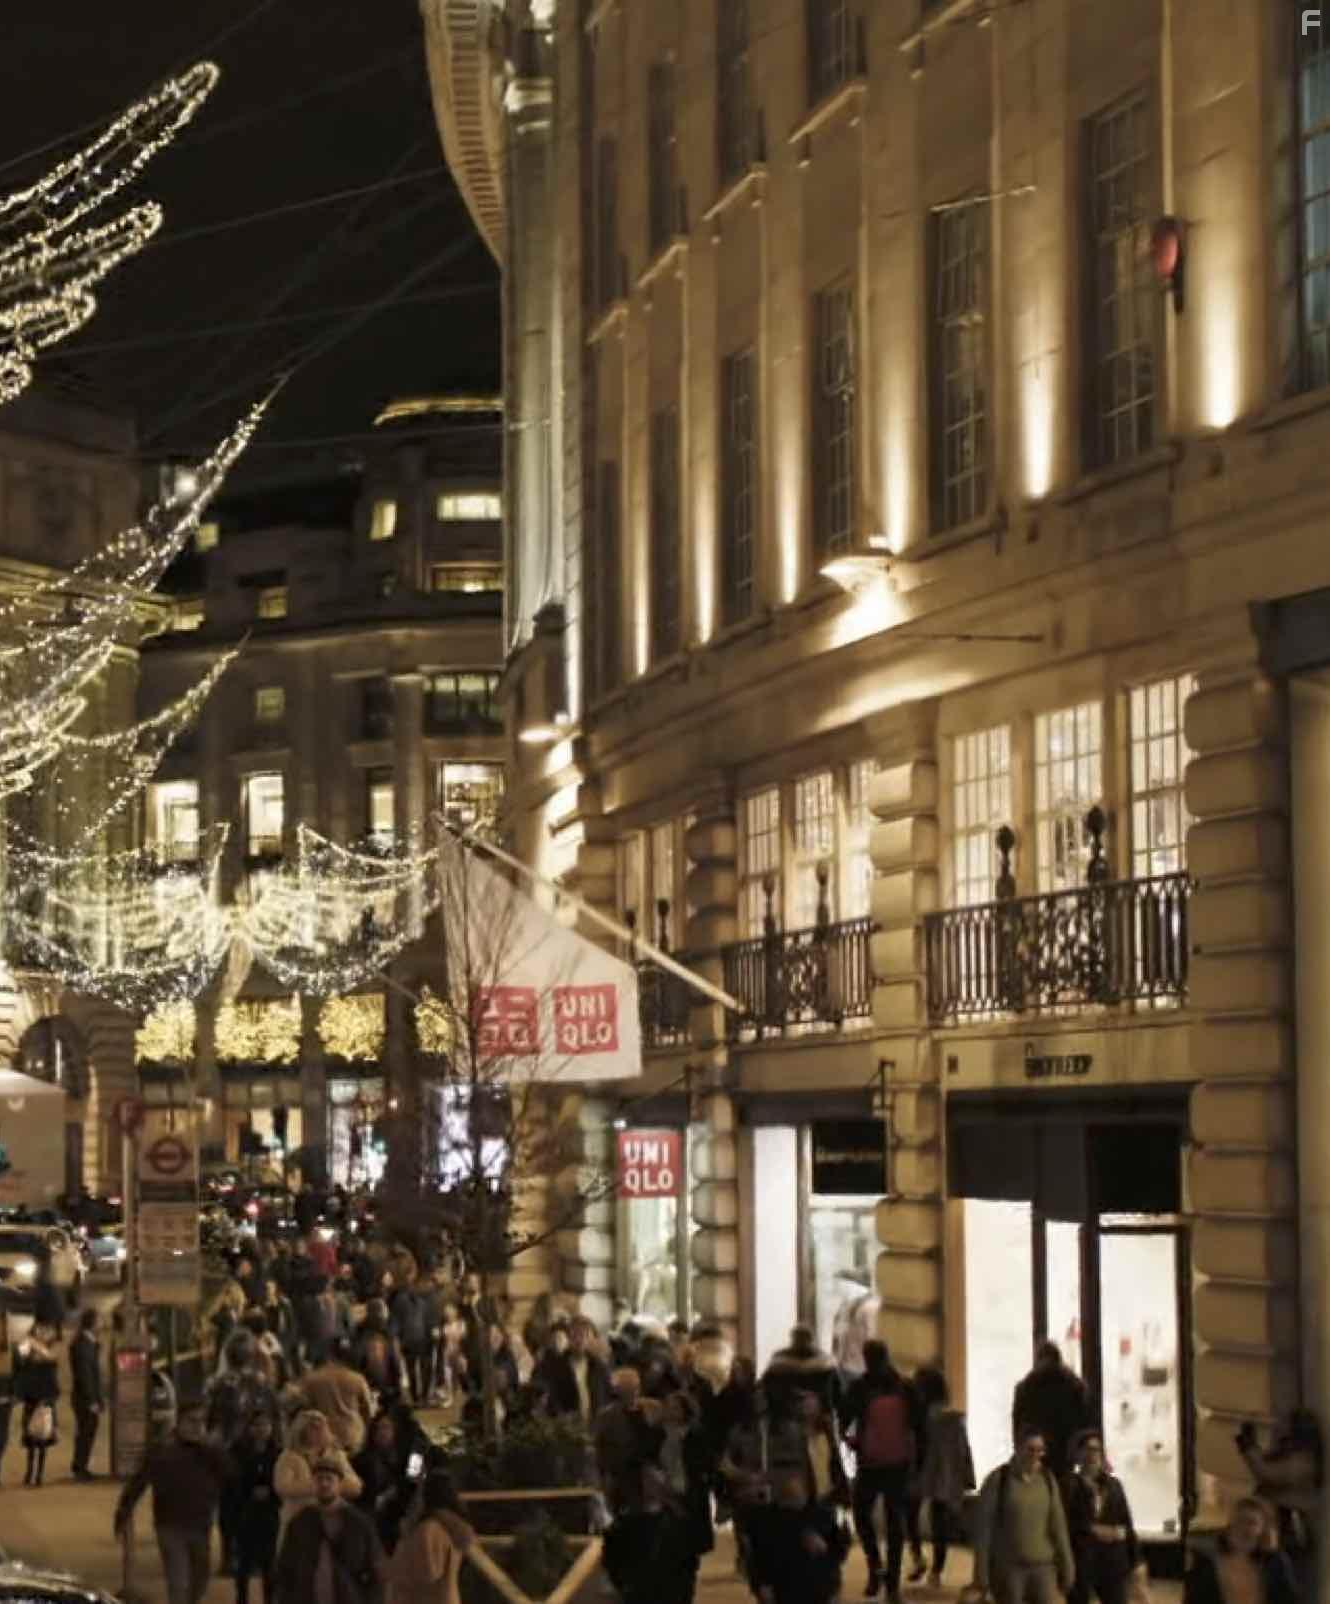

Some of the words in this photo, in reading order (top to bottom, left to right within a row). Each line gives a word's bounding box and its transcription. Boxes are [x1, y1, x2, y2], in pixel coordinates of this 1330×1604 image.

[561, 992, 606, 1018] UNI
[562, 1020, 612, 1049] QLO
[623, 1140, 669, 1166] UNI
[624, 1168, 673, 1194] QLO
